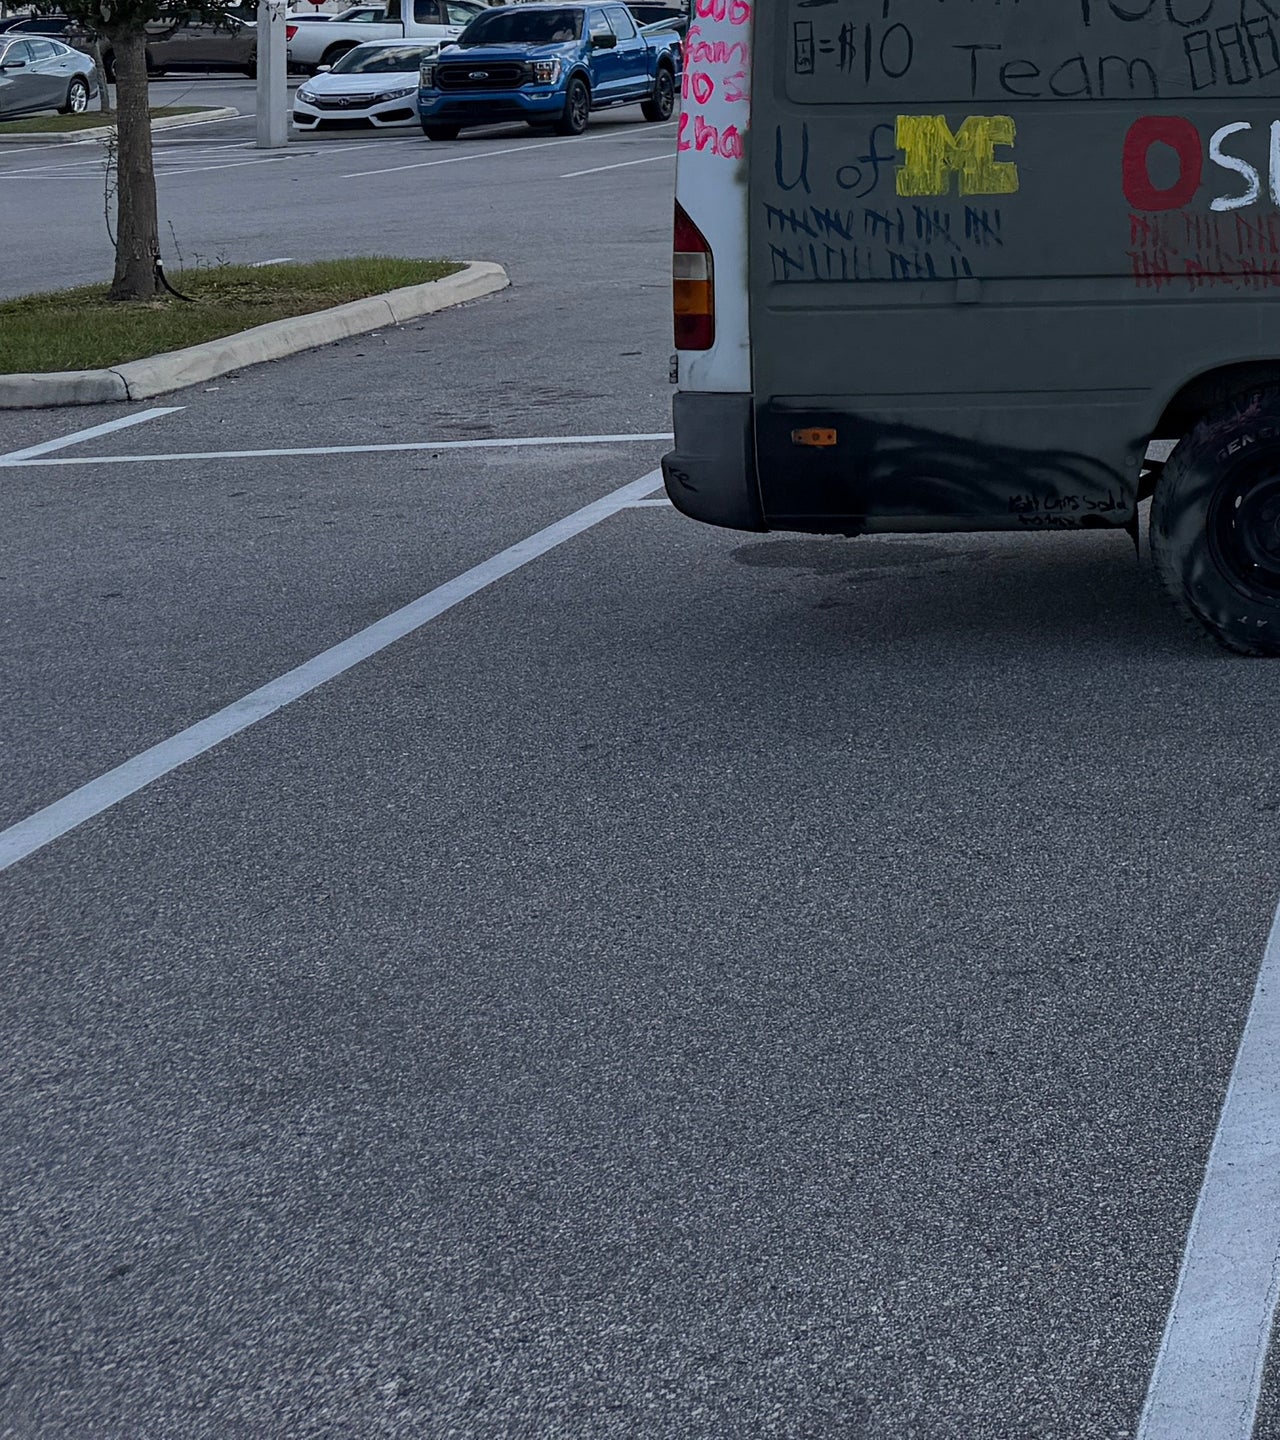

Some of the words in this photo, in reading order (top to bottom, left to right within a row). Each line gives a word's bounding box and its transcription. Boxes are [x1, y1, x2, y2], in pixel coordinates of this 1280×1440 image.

[951, 44, 1160, 98] Team
[774, 121, 812, 194] U
[836, 123, 896, 199] of
